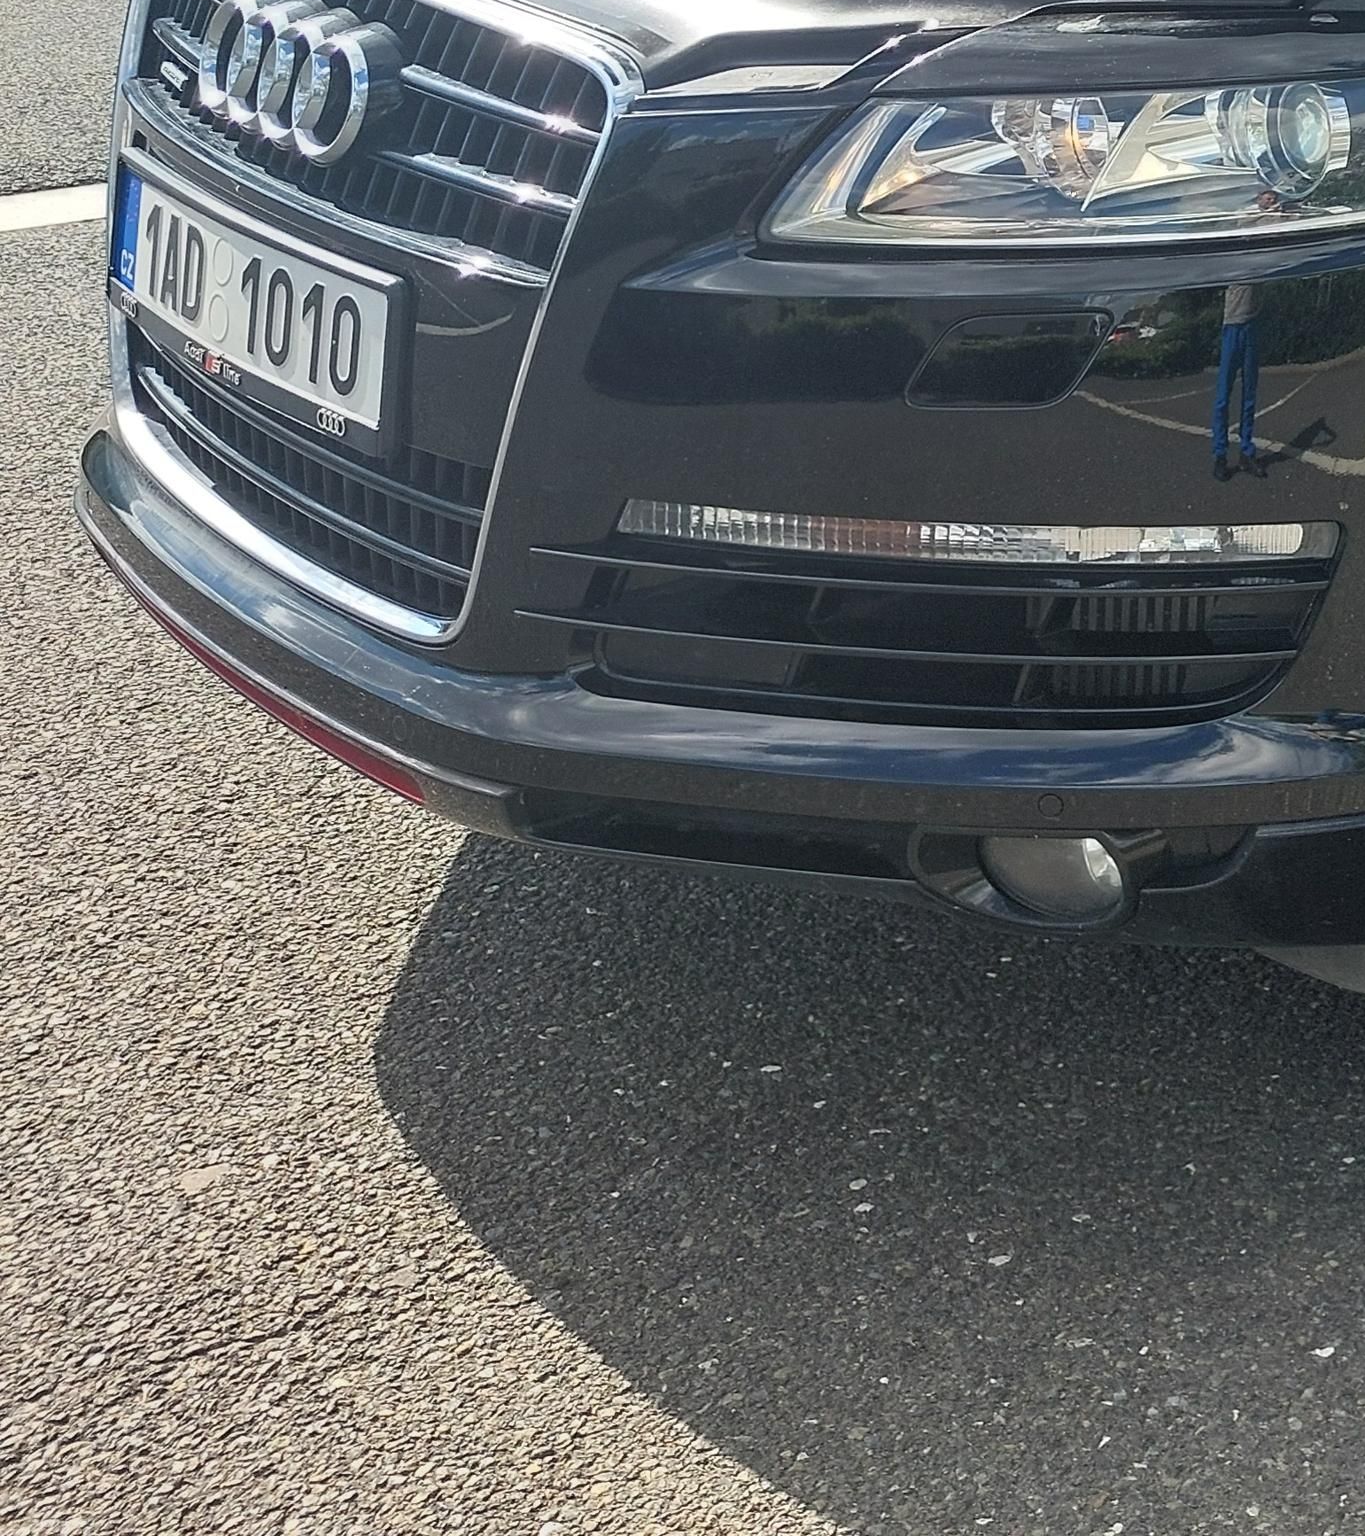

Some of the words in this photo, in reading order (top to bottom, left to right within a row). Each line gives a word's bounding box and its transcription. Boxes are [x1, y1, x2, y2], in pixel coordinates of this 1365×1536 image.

[120, 248, 135, 281] CZ
[146, 204, 204, 321] 1AD
[241, 255, 361, 397] 1010
